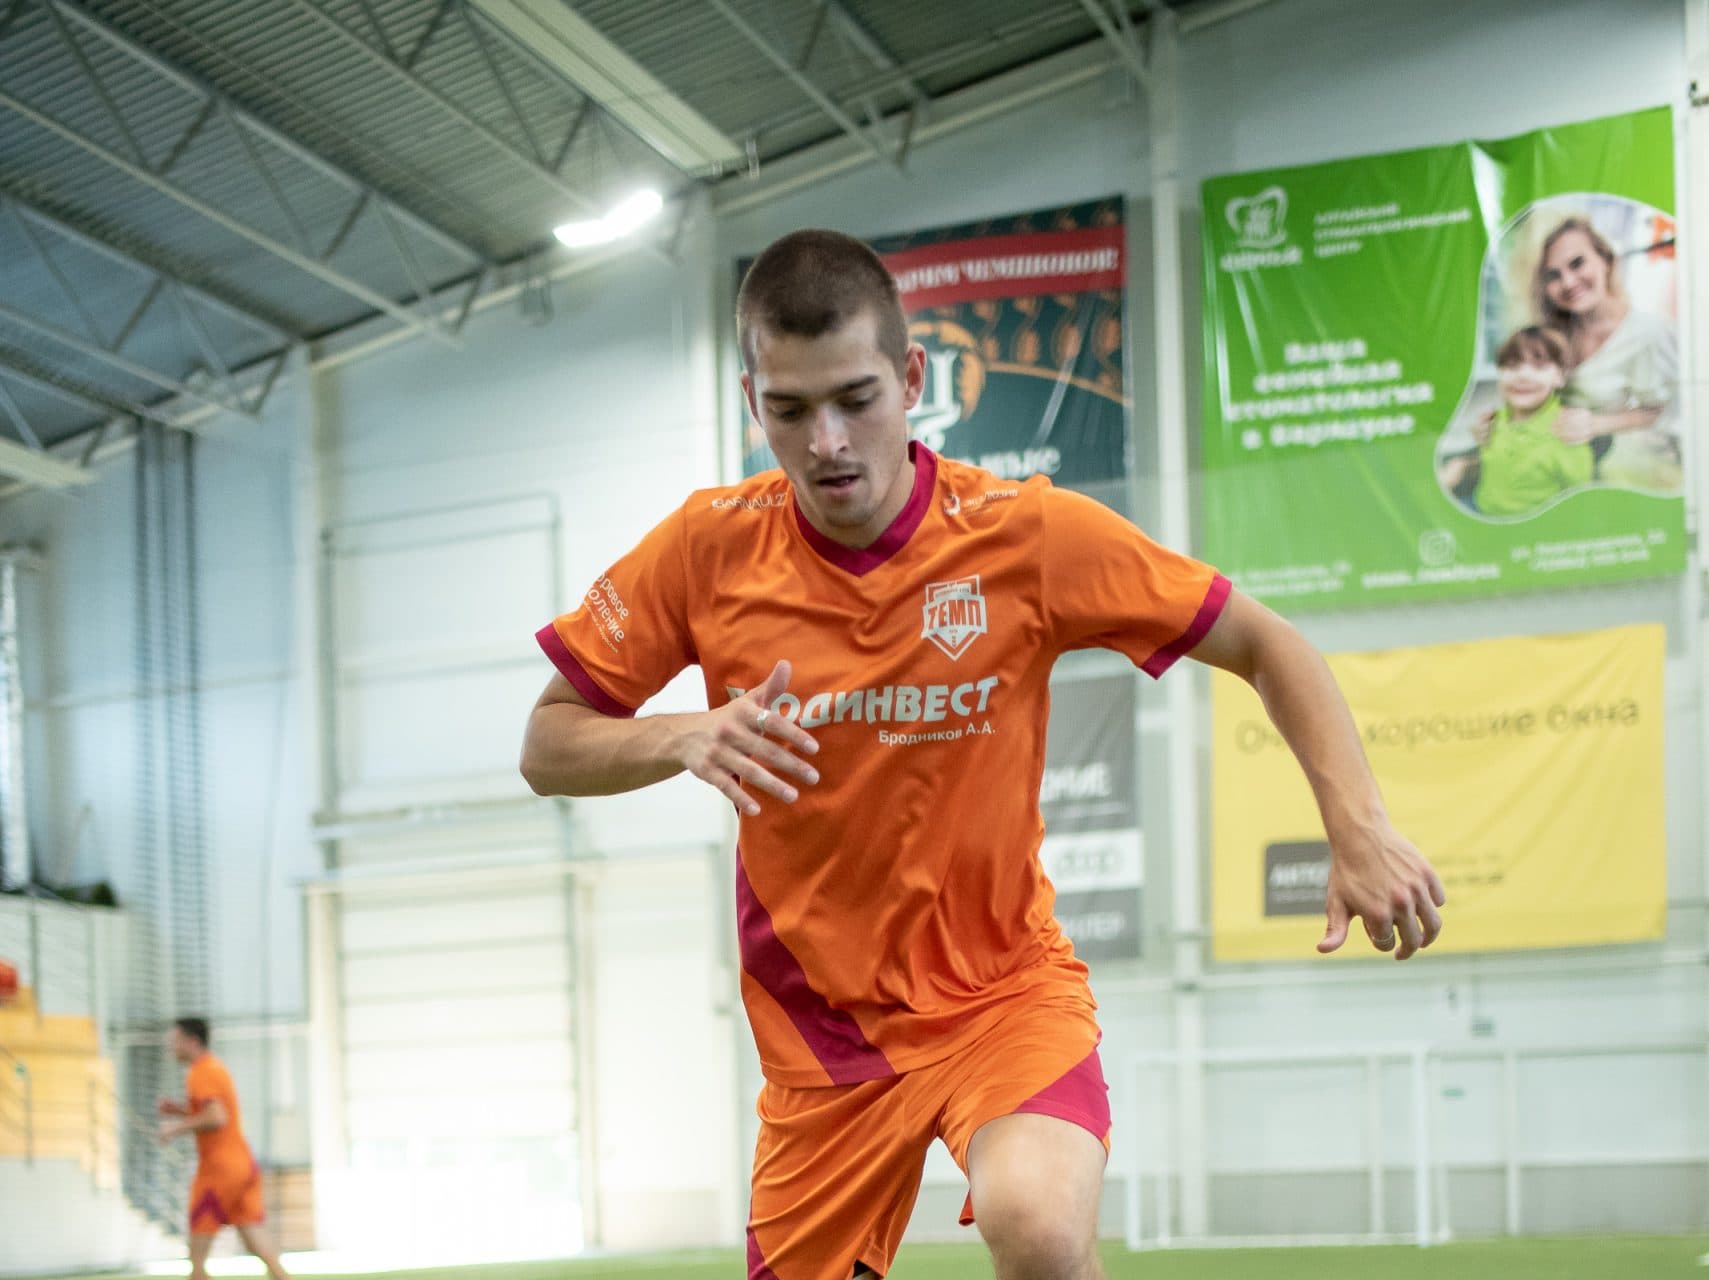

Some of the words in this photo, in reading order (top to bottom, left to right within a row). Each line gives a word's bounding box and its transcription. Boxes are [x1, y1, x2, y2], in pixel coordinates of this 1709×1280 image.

[927, 598, 982, 630] ТЕМП
[727, 675, 999, 729] ОДИНВЕСТ
[879, 728, 963, 747] Бродников
